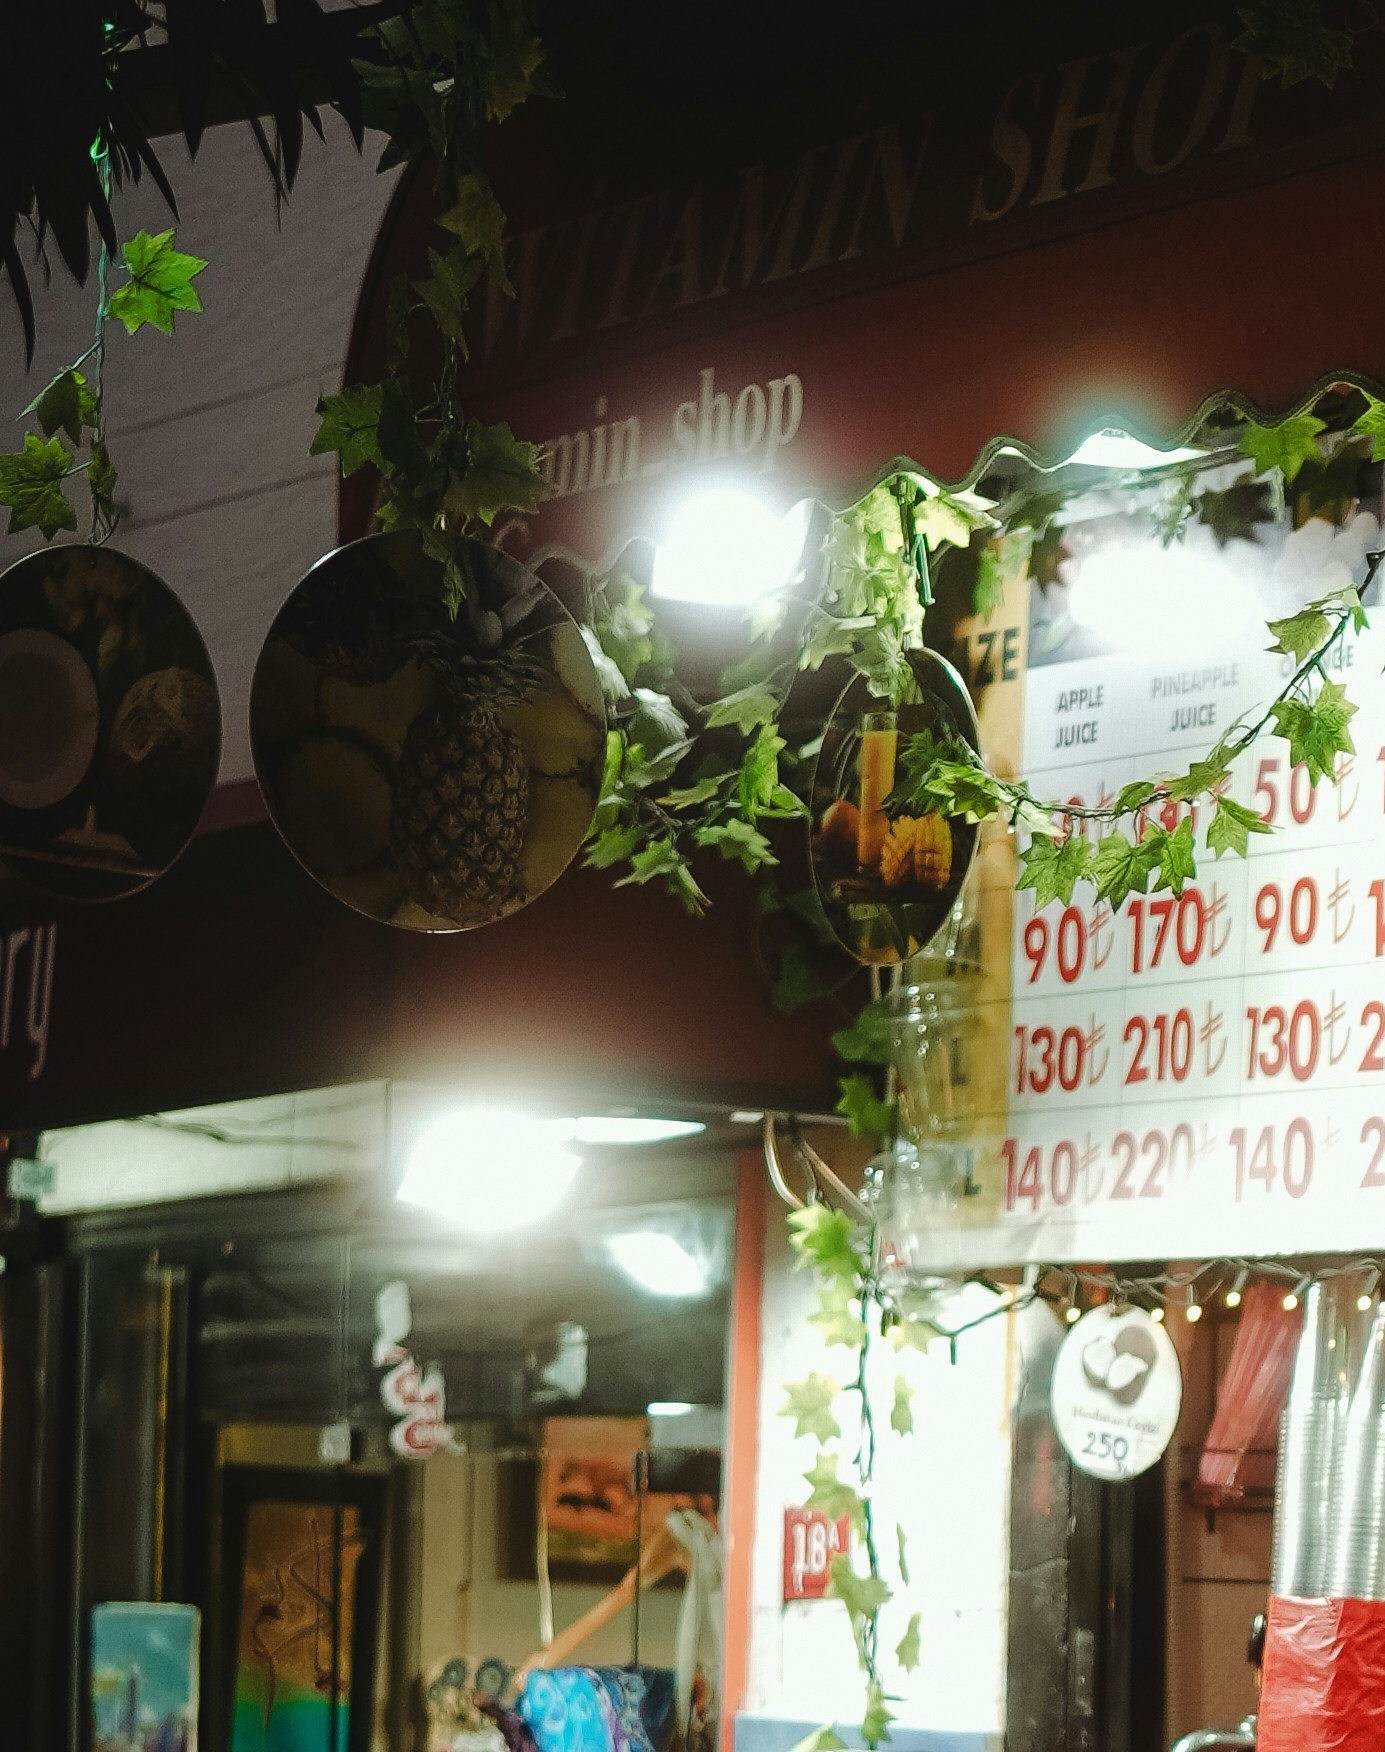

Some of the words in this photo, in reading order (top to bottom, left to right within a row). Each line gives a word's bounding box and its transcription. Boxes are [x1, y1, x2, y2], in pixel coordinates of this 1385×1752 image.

[538, 366, 804, 502] min_shop
[1150, 664, 1240, 699] PINEAPPLE
[1056, 684, 1105, 714] APPLE
[1170, 703, 1217, 732] JUICE
[1055, 720, 1099, 748] JUICE
[0, 920, 59, 1082] ry
[1082, 1430, 1130, 1462] 250
